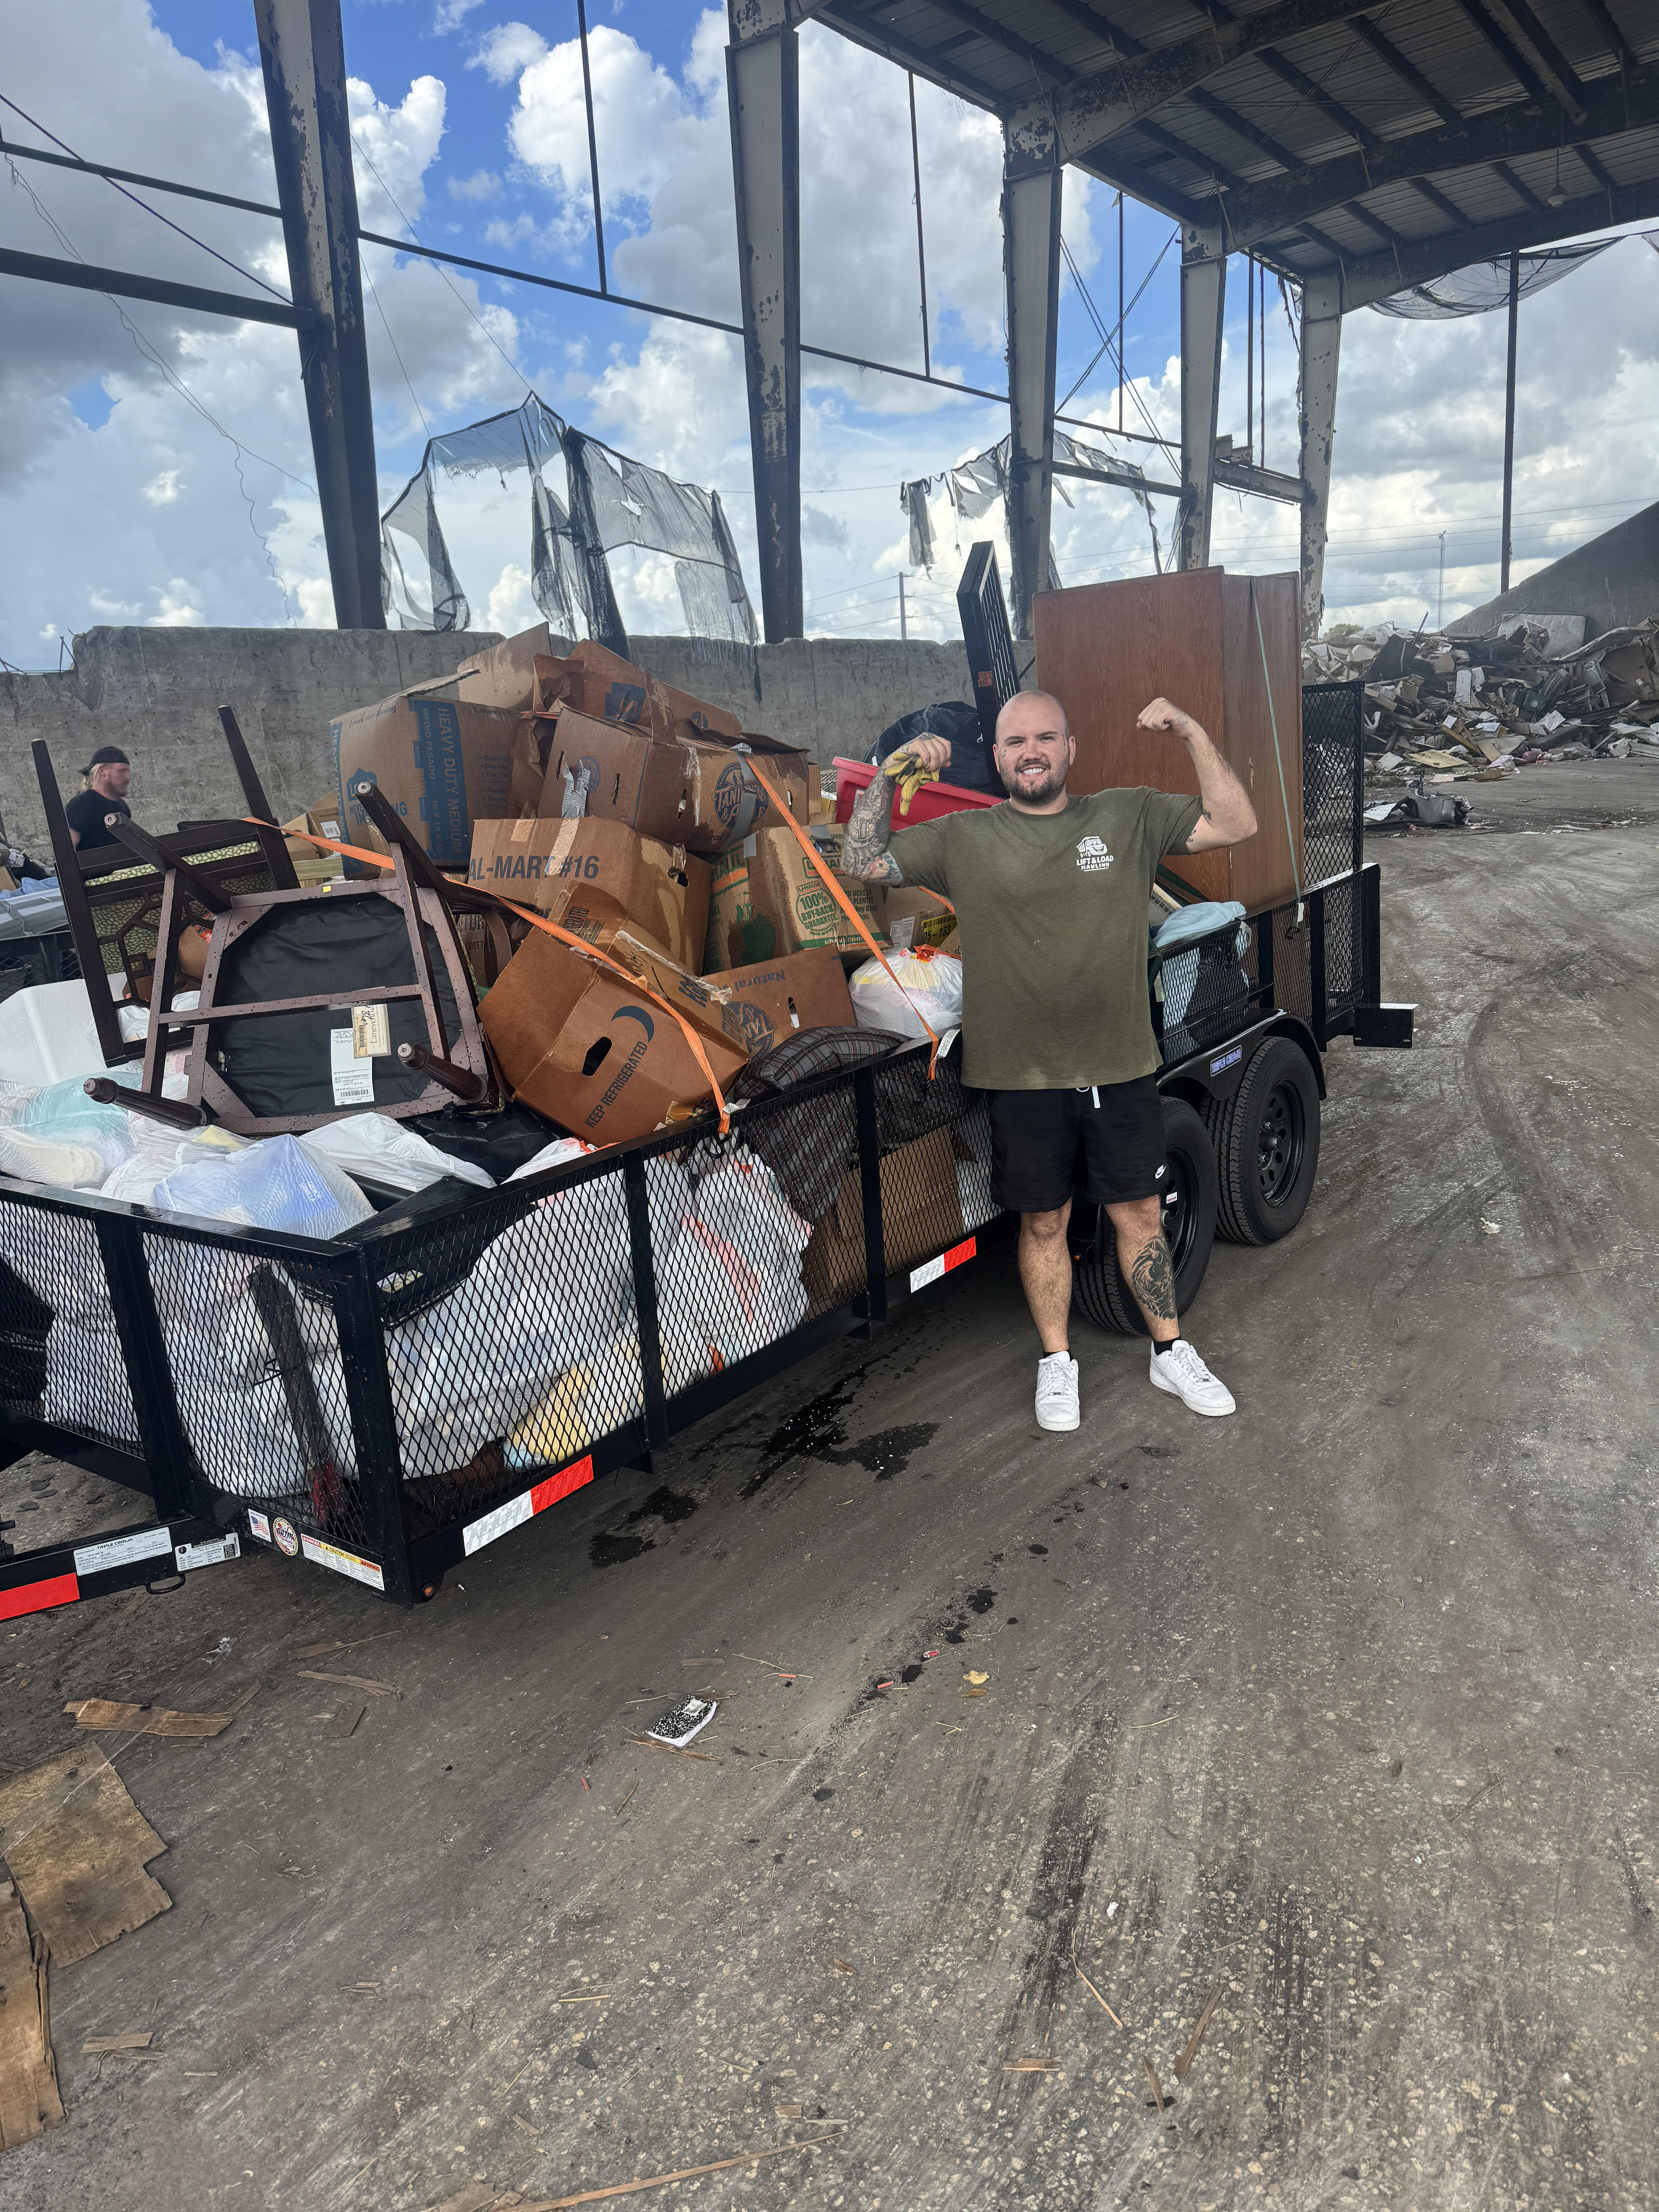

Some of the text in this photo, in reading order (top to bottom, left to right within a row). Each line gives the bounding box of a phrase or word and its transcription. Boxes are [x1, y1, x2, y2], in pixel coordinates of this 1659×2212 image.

[422, 708, 436, 780] MEDIO PESADO
[438, 708, 462, 853] HEAVY DUTY MEDIUM
[559, 855, 600, 879] #16
[1077, 857, 1091, 866] LIFT
[1097, 855, 1114, 863] LOAD
[1081, 862, 1109, 870] HAULING
[800, 891, 828, 910] 100%
[801, 903, 834, 922] BUY-BACK
[734, 970, 786, 992] Natural
[584, 1041, 648, 1128] KEEP REFRIGERATED
